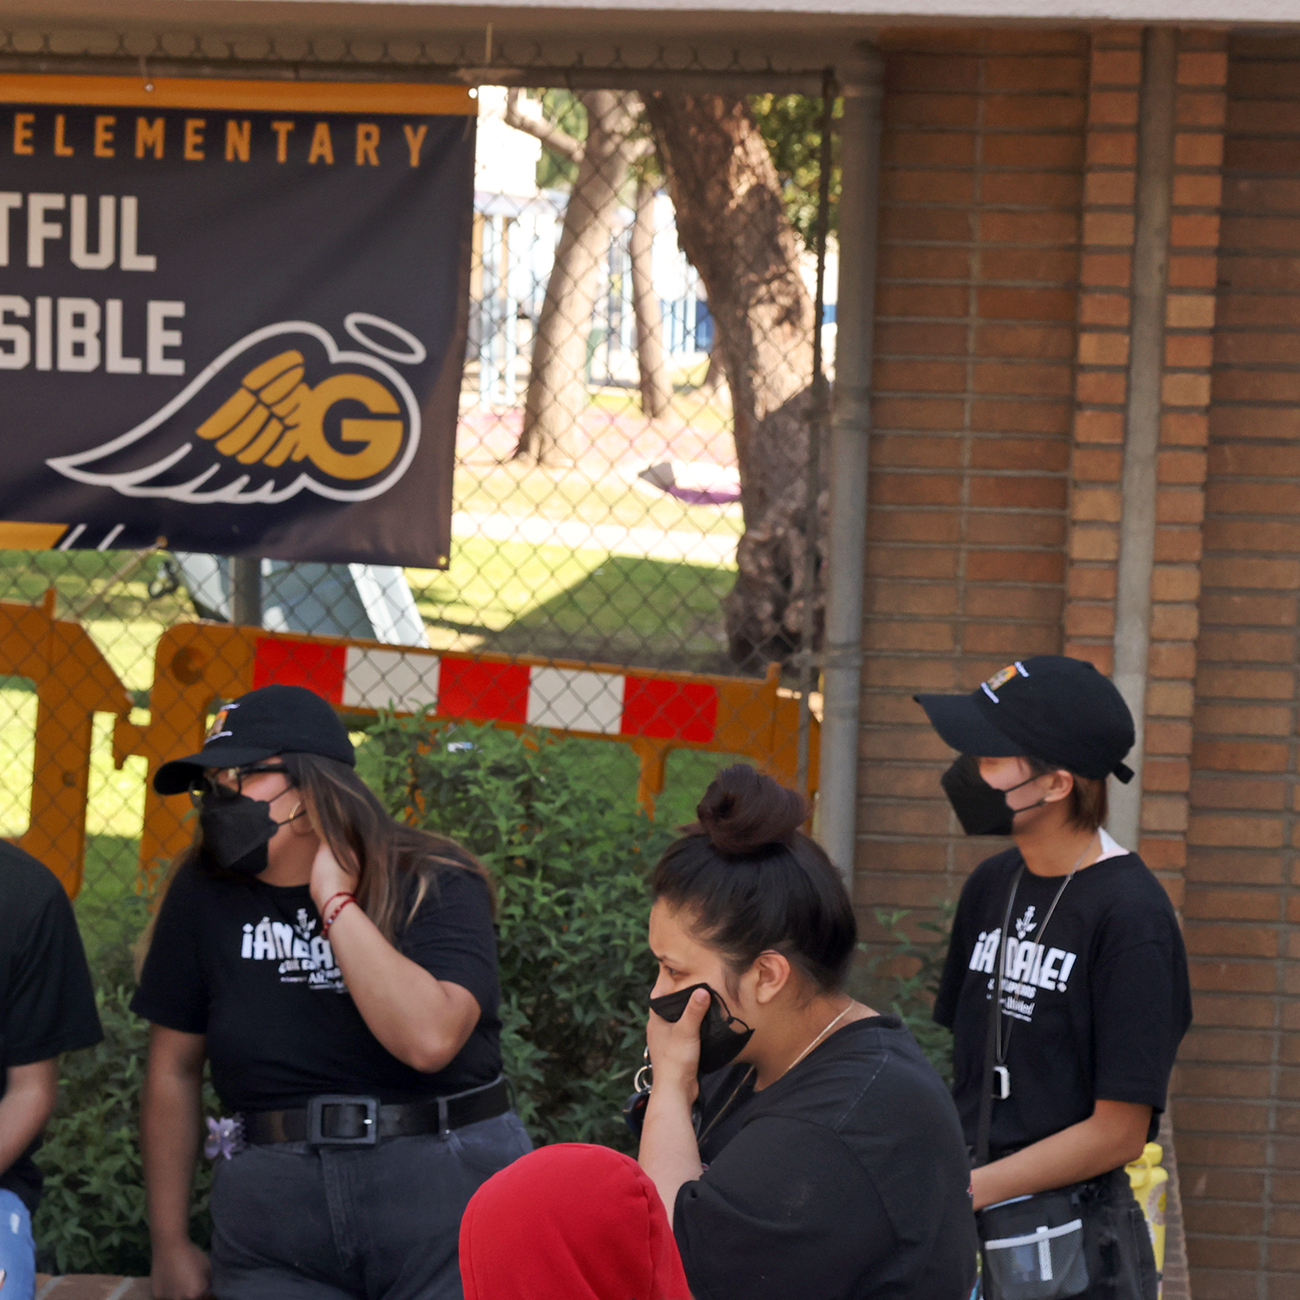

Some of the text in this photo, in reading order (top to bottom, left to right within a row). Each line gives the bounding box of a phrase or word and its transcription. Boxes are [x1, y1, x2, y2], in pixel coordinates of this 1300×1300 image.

[12, 111, 430, 169] ELEMENTARY
[302, 372, 405, 481] G
[968, 927, 1078, 993] ¡ÁDALE!
